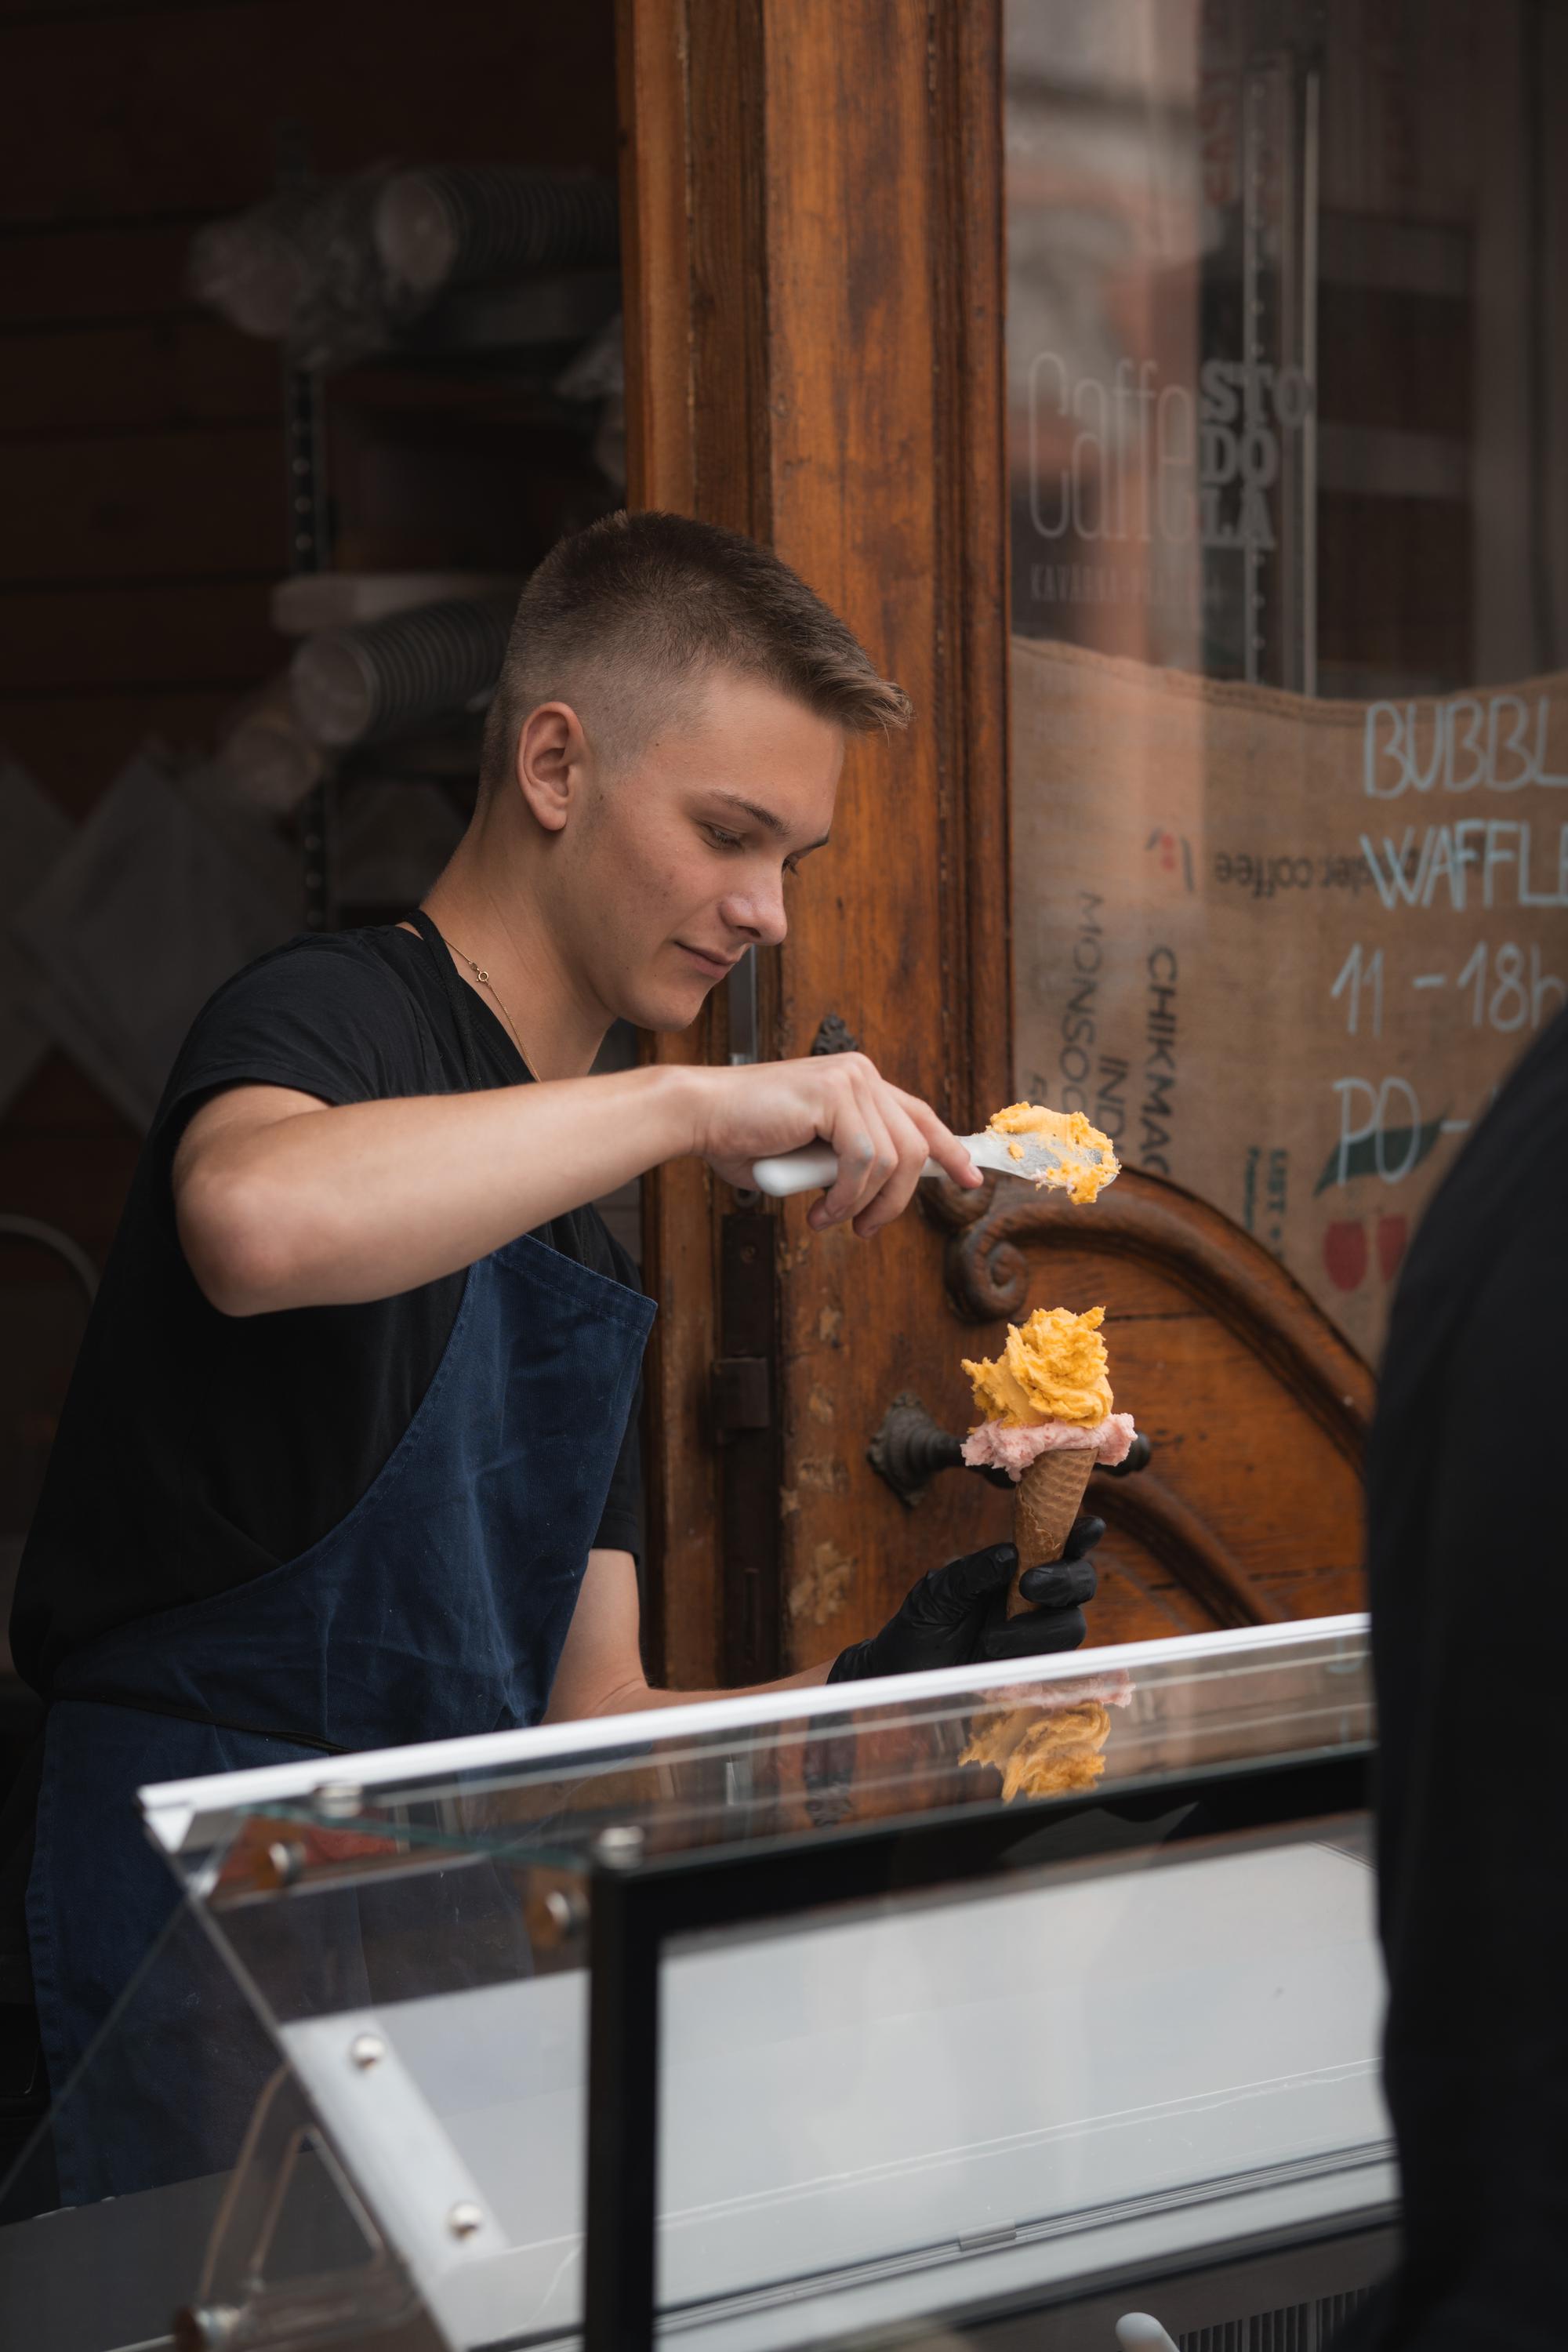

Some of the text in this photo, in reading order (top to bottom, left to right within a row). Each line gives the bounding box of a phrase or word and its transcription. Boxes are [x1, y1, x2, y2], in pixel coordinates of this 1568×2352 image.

[1200, 358, 1311, 429] STO
[1200, 423, 1279, 488] DO
[1200, 486, 1278, 549] LA
[1215, 849, 1312, 900] coffee
[1330, 942, 1385, 1038] 11
[1333, 1076, 1421, 1186] PO
